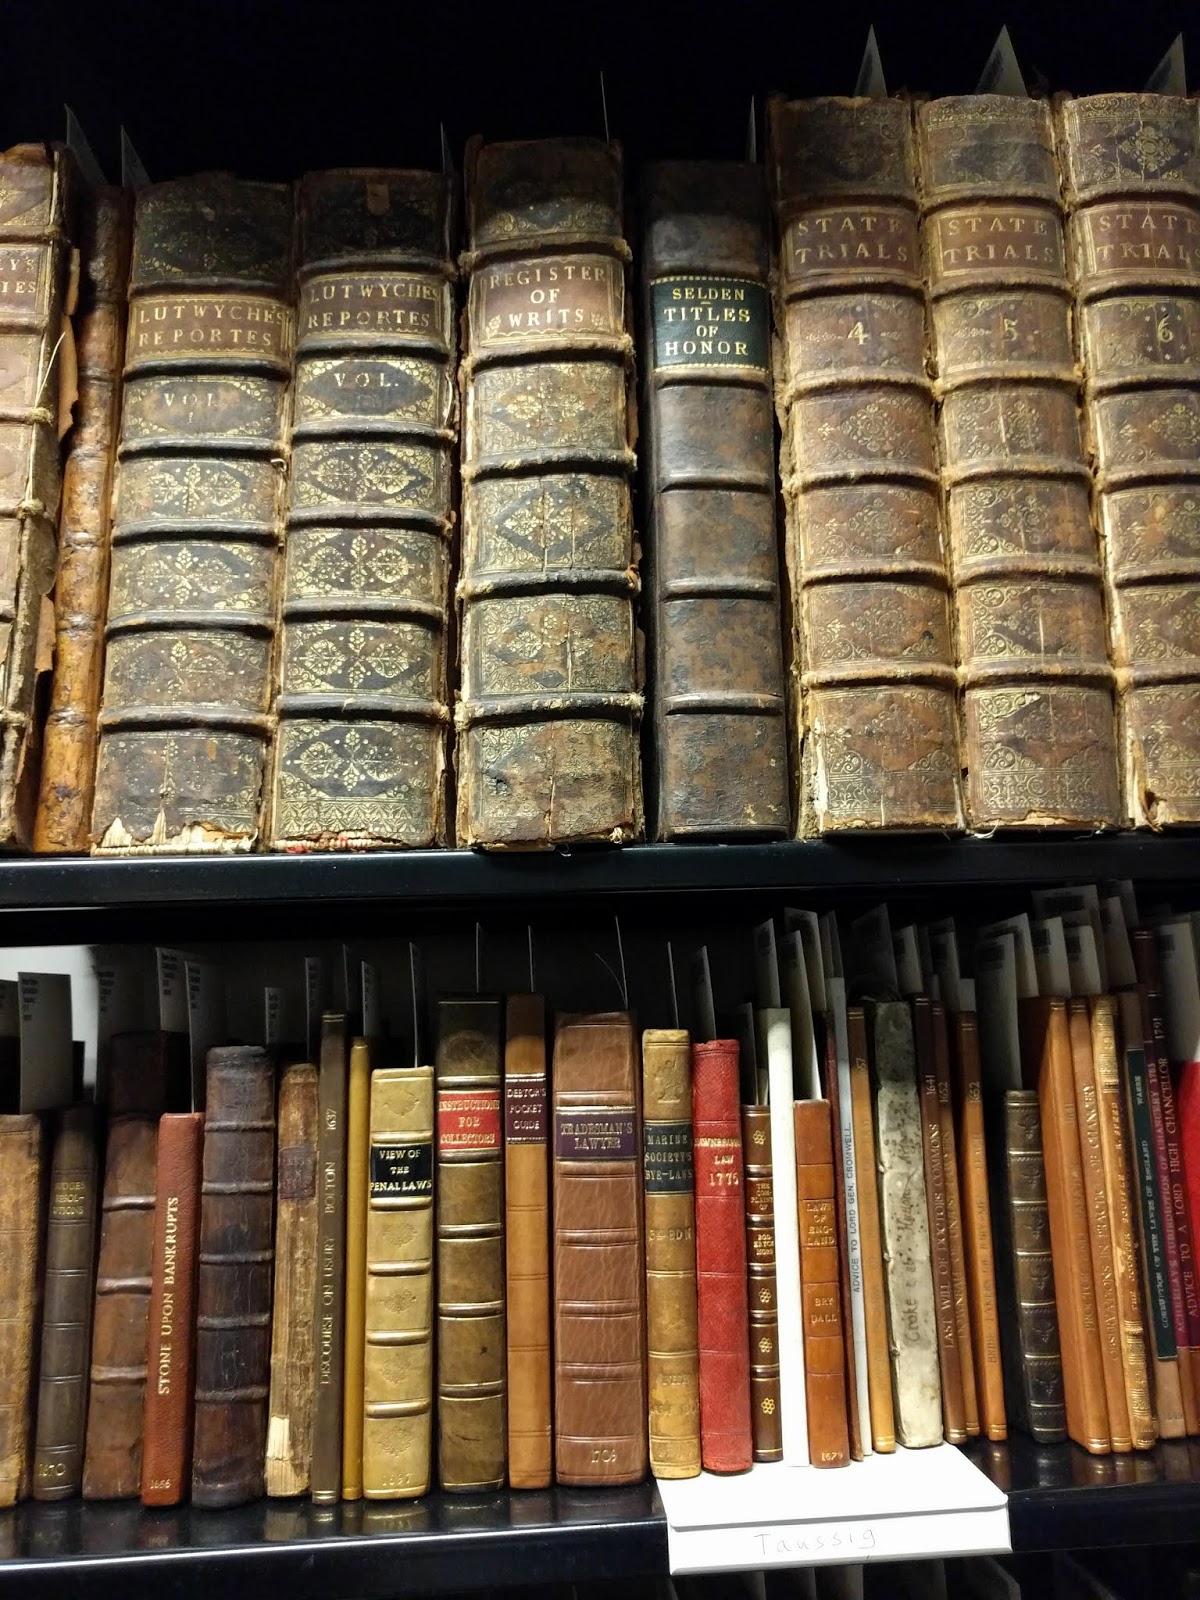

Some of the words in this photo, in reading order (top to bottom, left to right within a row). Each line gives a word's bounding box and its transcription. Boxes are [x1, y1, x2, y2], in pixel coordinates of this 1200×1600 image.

[798, 217, 901, 236] STATE
[948, 217, 1047, 236] STATE
[796, 243, 908, 263] TRIALS
[944, 244, 1054, 263] TRIALS
[490, 265, 605, 288] REGISTER
[530, 289, 560, 305] OF
[672, 287, 745, 301] SELDEN
[308, 309, 430, 329] REPORTES
[508, 309, 584, 328] WRITS
[664, 307, 751, 323] TITLES
[696, 325, 719, 338] OF
[846, 320, 868, 346] 4
[1002, 318, 1018, 343] 5
[1157, 312, 1174, 345] 6
[139, 329, 272, 348] REPORTES
[664, 341, 749, 358] HONOR
[939, 1081, 949, 1103] 1652
[969, 1081, 981, 1104] 1652
[1157, 1057, 1177, 1134] CHANCELLOR
[510, 1104, 543, 1114] POCKET
[1082, 1083, 1099, 1149] CHANCERY
[458, 1116, 480, 1128] FOR
[513, 1120, 541, 1130] GUIDE
[560, 1122, 633, 1136] TRADESMAN'S
[1150, 1090, 1166, 1151] CHANCERY
[440, 1133, 496, 1145] COLLECTORS
[574, 1137, 621, 1150] LAWYER
[647, 1134, 688, 1145] MARINE
[379, 1150, 406, 1160] VIEW
[407, 1149, 421, 1159] OF
[714, 1154, 734, 1165] LAW
[928, 1122, 943, 1187] COMMONS
[1141, 1140, 1153, 1181] ENGLAND
[1160, 1155, 1168, 1170] OF
[1168, 1143, 1181, 1173] HIGH
[390, 1166, 410, 1175] THE
[709, 1171, 739, 1187] 1775
[323, 1162, 336, 1214] BOLTON
[370, 1181, 400, 1191] PENAL
[402, 1179, 432, 1190] LAWS
[1145, 1185, 1153, 1197] OF
[1173, 1183, 1185, 1215] LORD
[813, 1214, 827, 1224] OF
[848, 1210, 857, 1235] LORD
[934, 1192, 948, 1251] DOCTORS
[1161, 1174, 1177, 1255] JURISDICTION
[1178, 1225, 1188, 1233] A
[163, 1196, 179, 1285] BANKRUPTS
[850, 1239, 859, 1253] TO
[1151, 1234, 1159, 1253] THE
[322, 1237, 335, 1277] USURY
[1153, 1255, 1161, 1268] OF
[1179, 1243, 1191, 1262] TO
[851, 1257, 861, 1293] ADVICE
[937, 1257, 949, 1276] OF
[321, 1284, 333, 1306] ON
[939, 1281, 952, 1311] WILL
[1129, 1291, 1138, 1311] THE
[1183, 1271, 1199, 1318] ADVICE
[160, 1292, 174, 1336] UPON
[940, 1319, 955, 1348] LAST
[319, 1314, 333, 1385] DISCOURSE
[158, 1343, 171, 1395] STONE
[820, 1451, 844, 1462] 1679
[753, 1529, 876, 1556] Taussig
